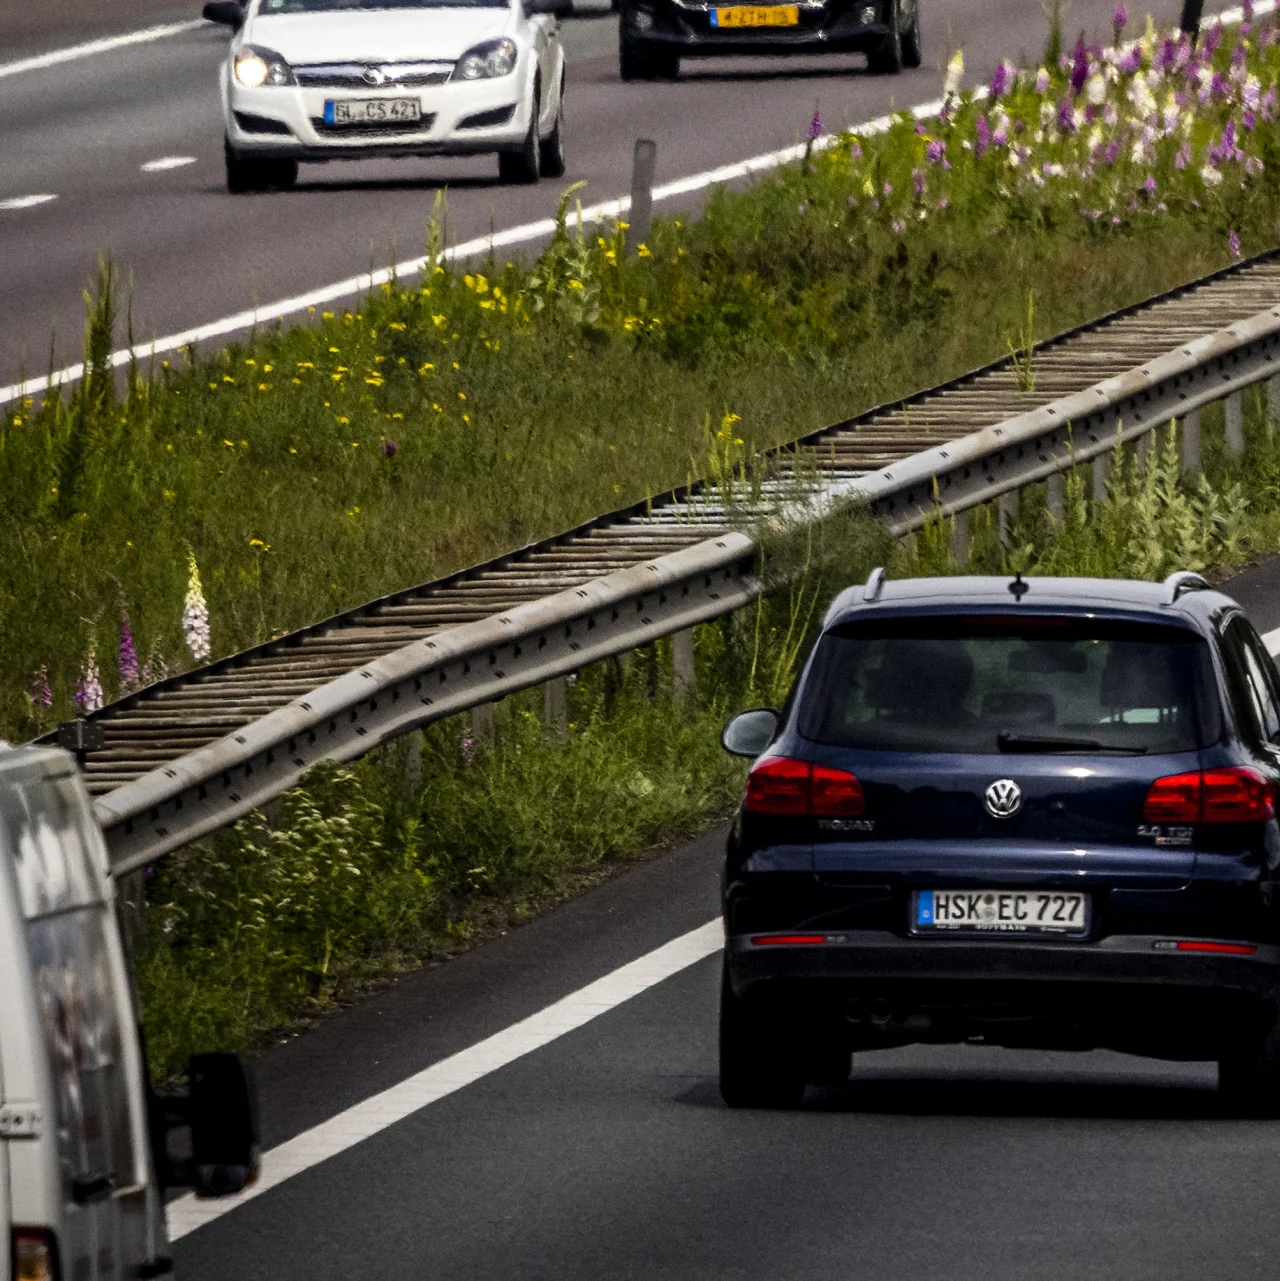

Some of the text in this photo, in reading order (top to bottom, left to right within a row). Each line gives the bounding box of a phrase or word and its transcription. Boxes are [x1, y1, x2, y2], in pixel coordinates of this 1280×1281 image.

[935, 894, 1081, 921] HSK EC 727
